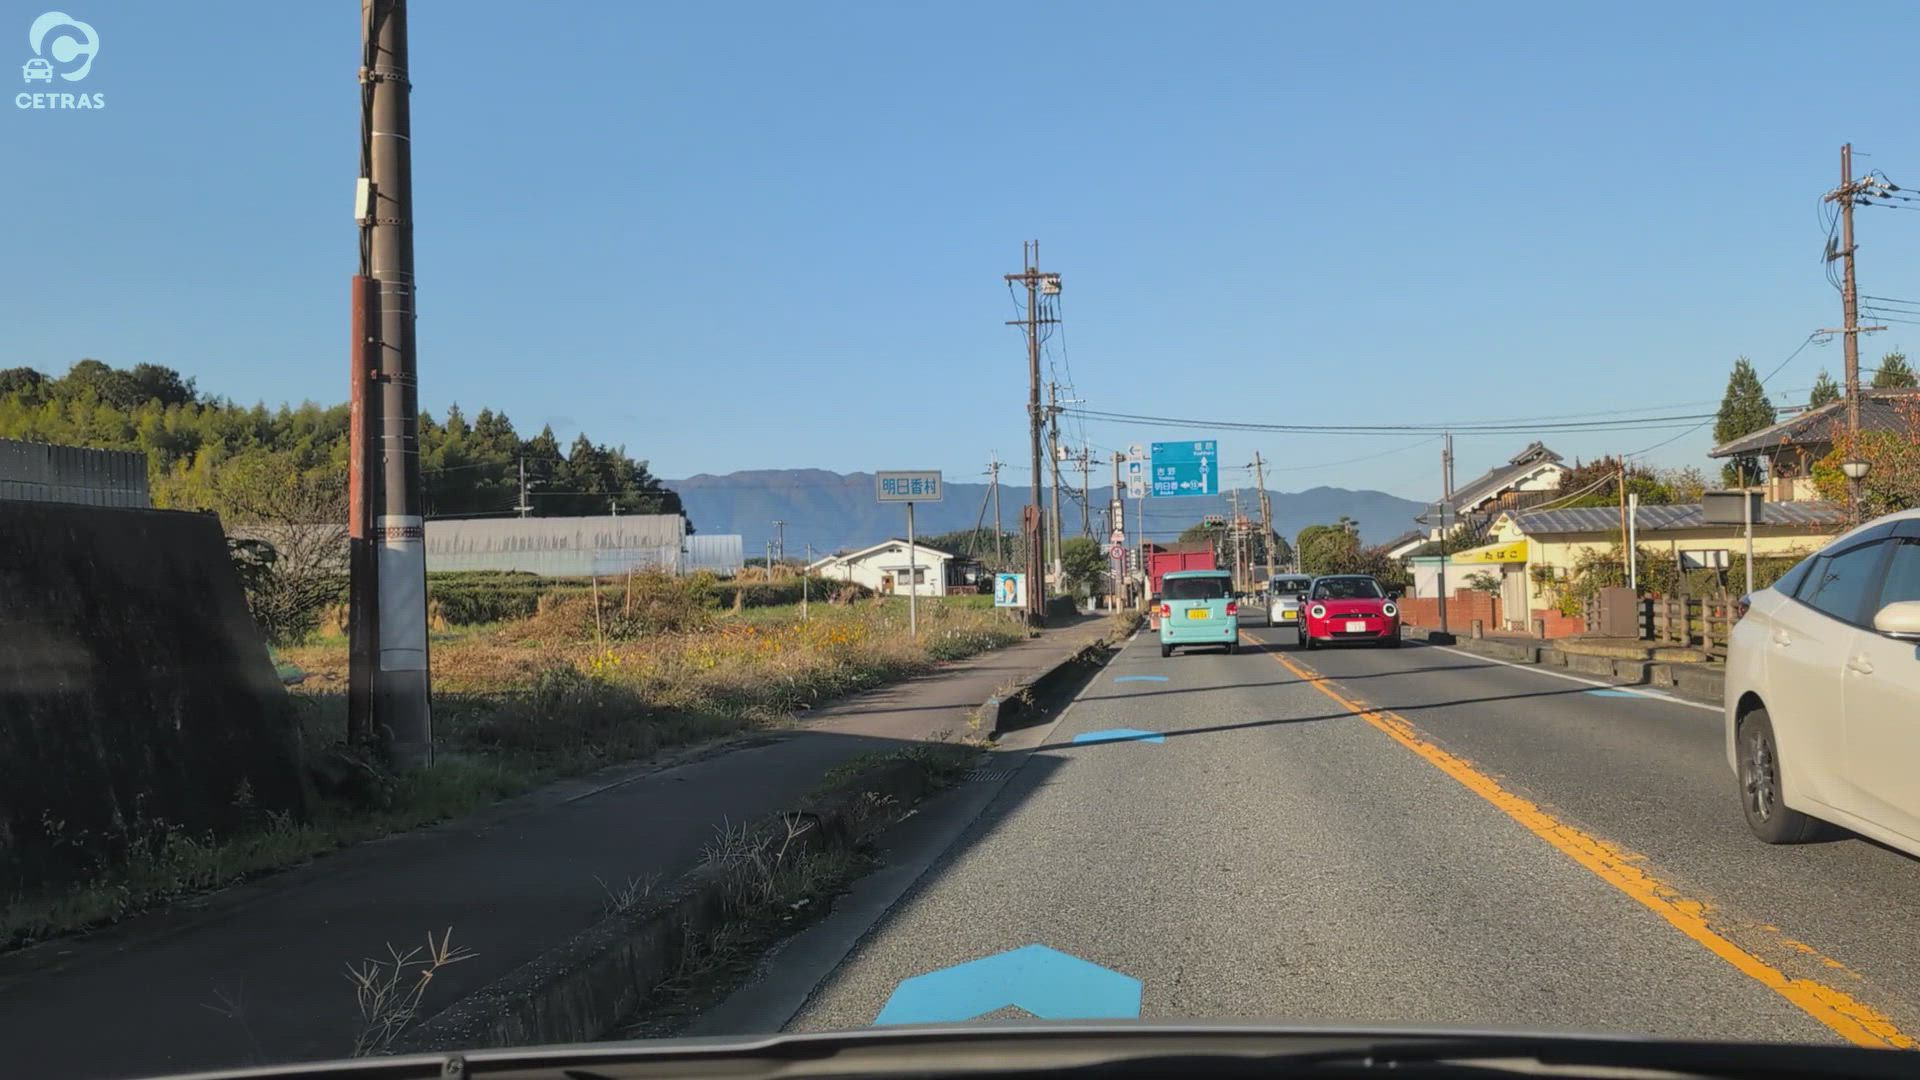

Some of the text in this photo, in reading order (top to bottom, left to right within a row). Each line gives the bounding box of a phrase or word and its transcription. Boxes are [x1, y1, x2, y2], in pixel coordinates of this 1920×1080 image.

[882, 478, 936, 495] 明日香村
[1485, 550, 1518, 560] たばこ
